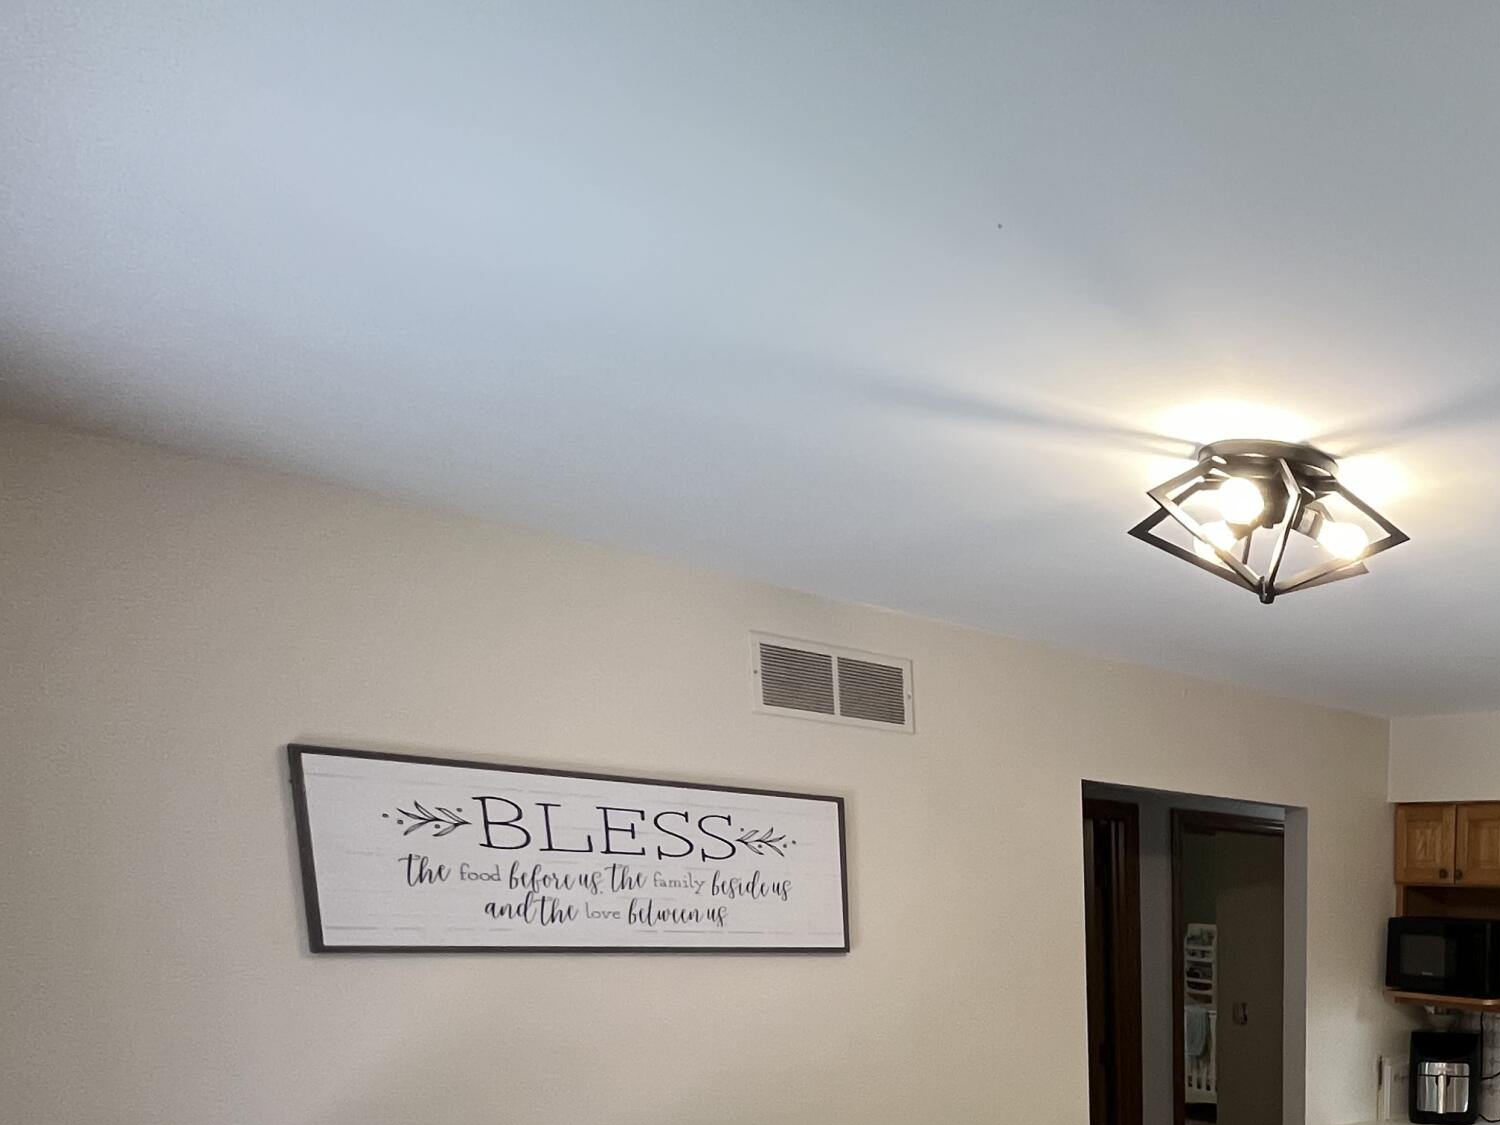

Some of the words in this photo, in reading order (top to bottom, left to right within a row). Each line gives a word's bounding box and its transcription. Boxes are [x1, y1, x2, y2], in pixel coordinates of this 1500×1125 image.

[472, 796, 737, 862] BLESS
[398, 853, 451, 887] the
[460, 863, 502, 882] food
[508, 860, 577, 894] before
[604, 863, 647, 893] the
[653, 871, 705, 895] family
[711, 870, 771, 900] beside
[771, 879, 792, 901] us
[484, 891, 537, 925] and
[535, 895, 579, 926] the
[585, 902, 621, 919] love
[628, 898, 705, 927] between
[706, 905, 728, 927] us
